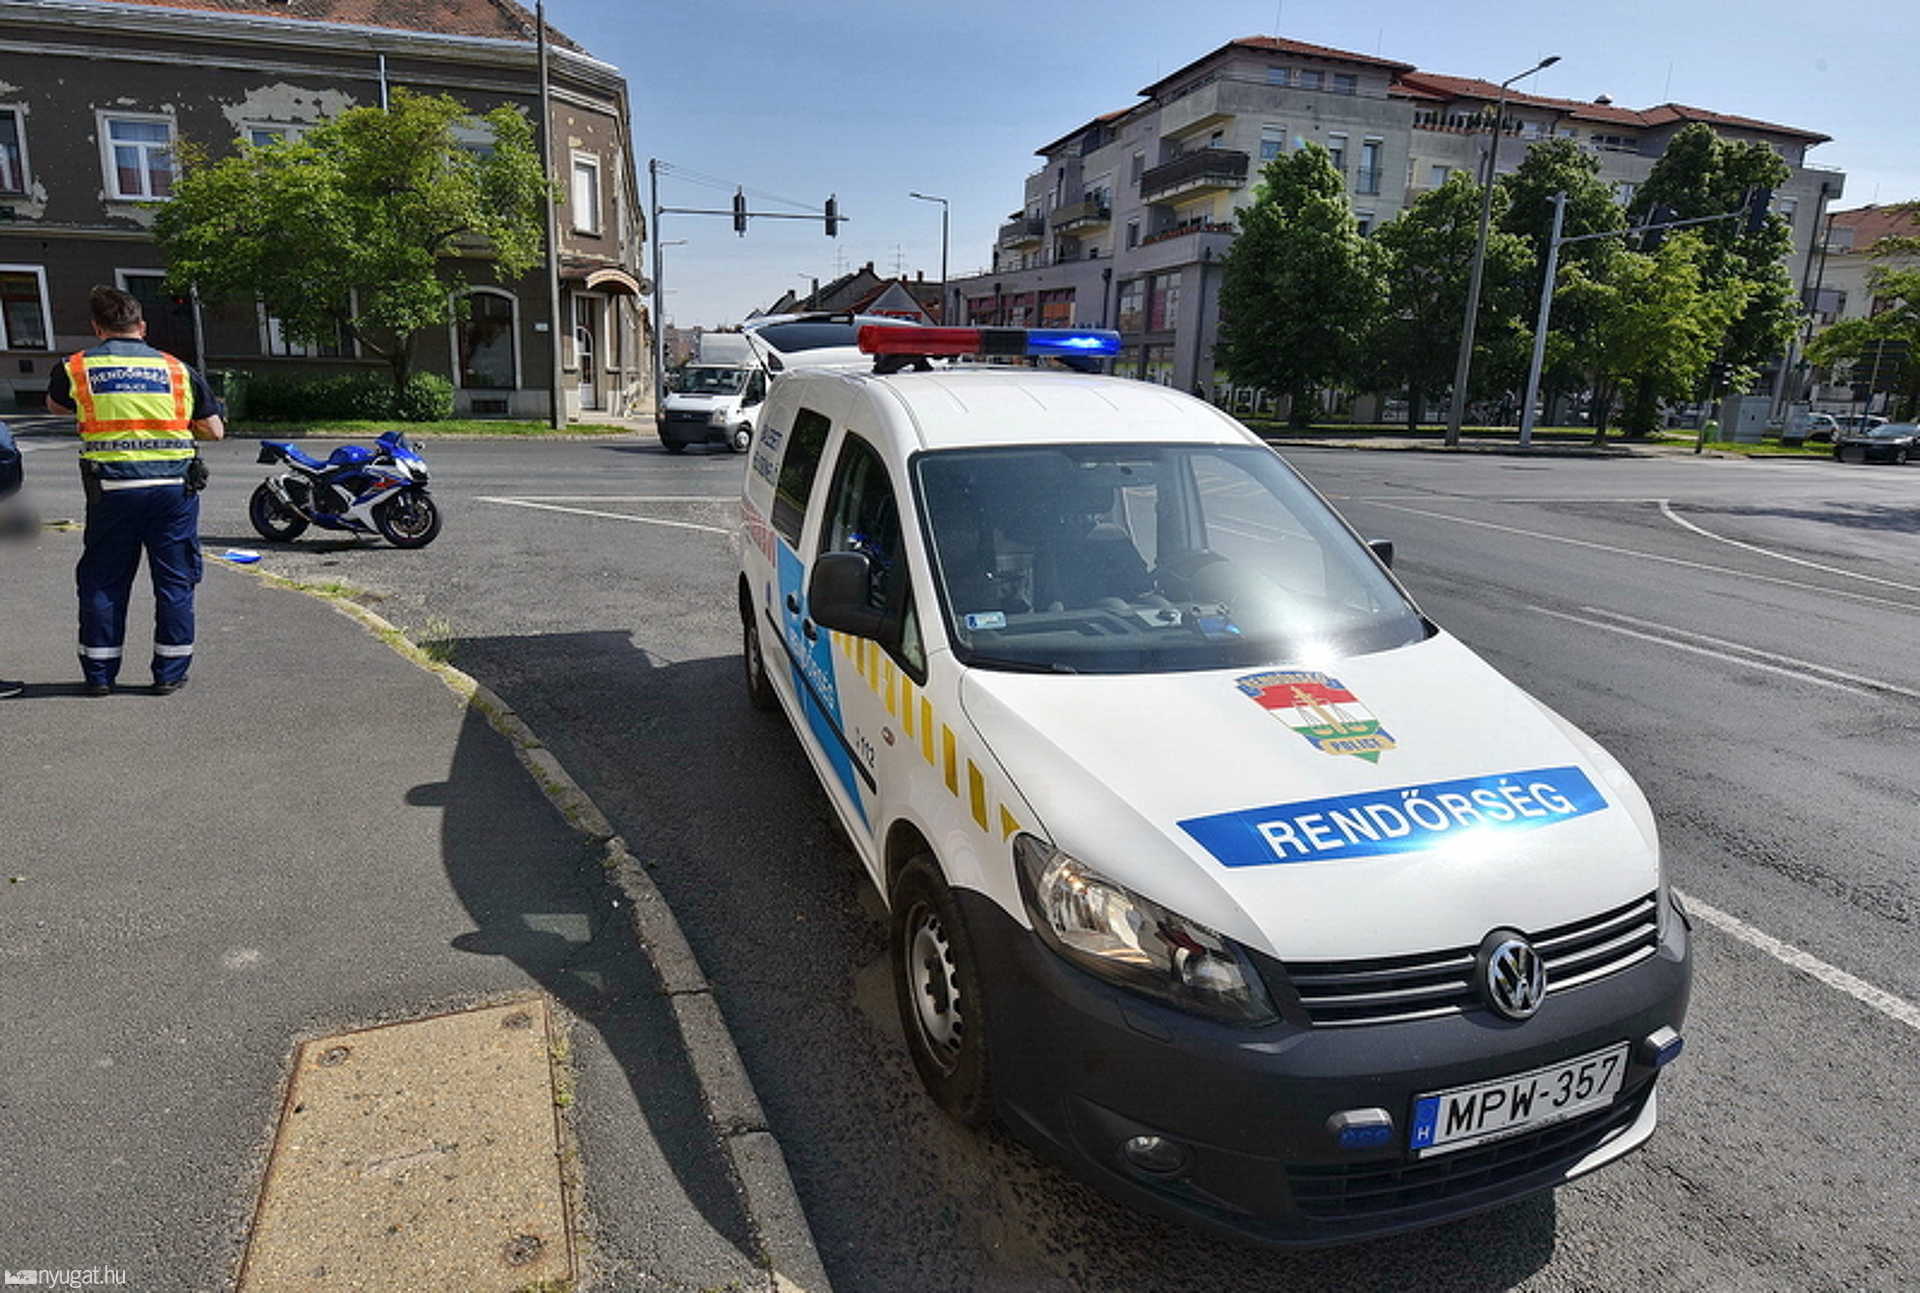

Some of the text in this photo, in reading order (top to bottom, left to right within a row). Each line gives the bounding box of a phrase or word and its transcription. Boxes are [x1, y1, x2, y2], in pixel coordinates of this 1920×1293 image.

[112, 440, 160, 450] POLICE
[1330, 736, 1381, 751] POLICE
[1256, 778, 1578, 859] RENDŐRSÉG
[1445, 1055, 1619, 1136] MPW-357
[1417, 1127, 1430, 1140] H
